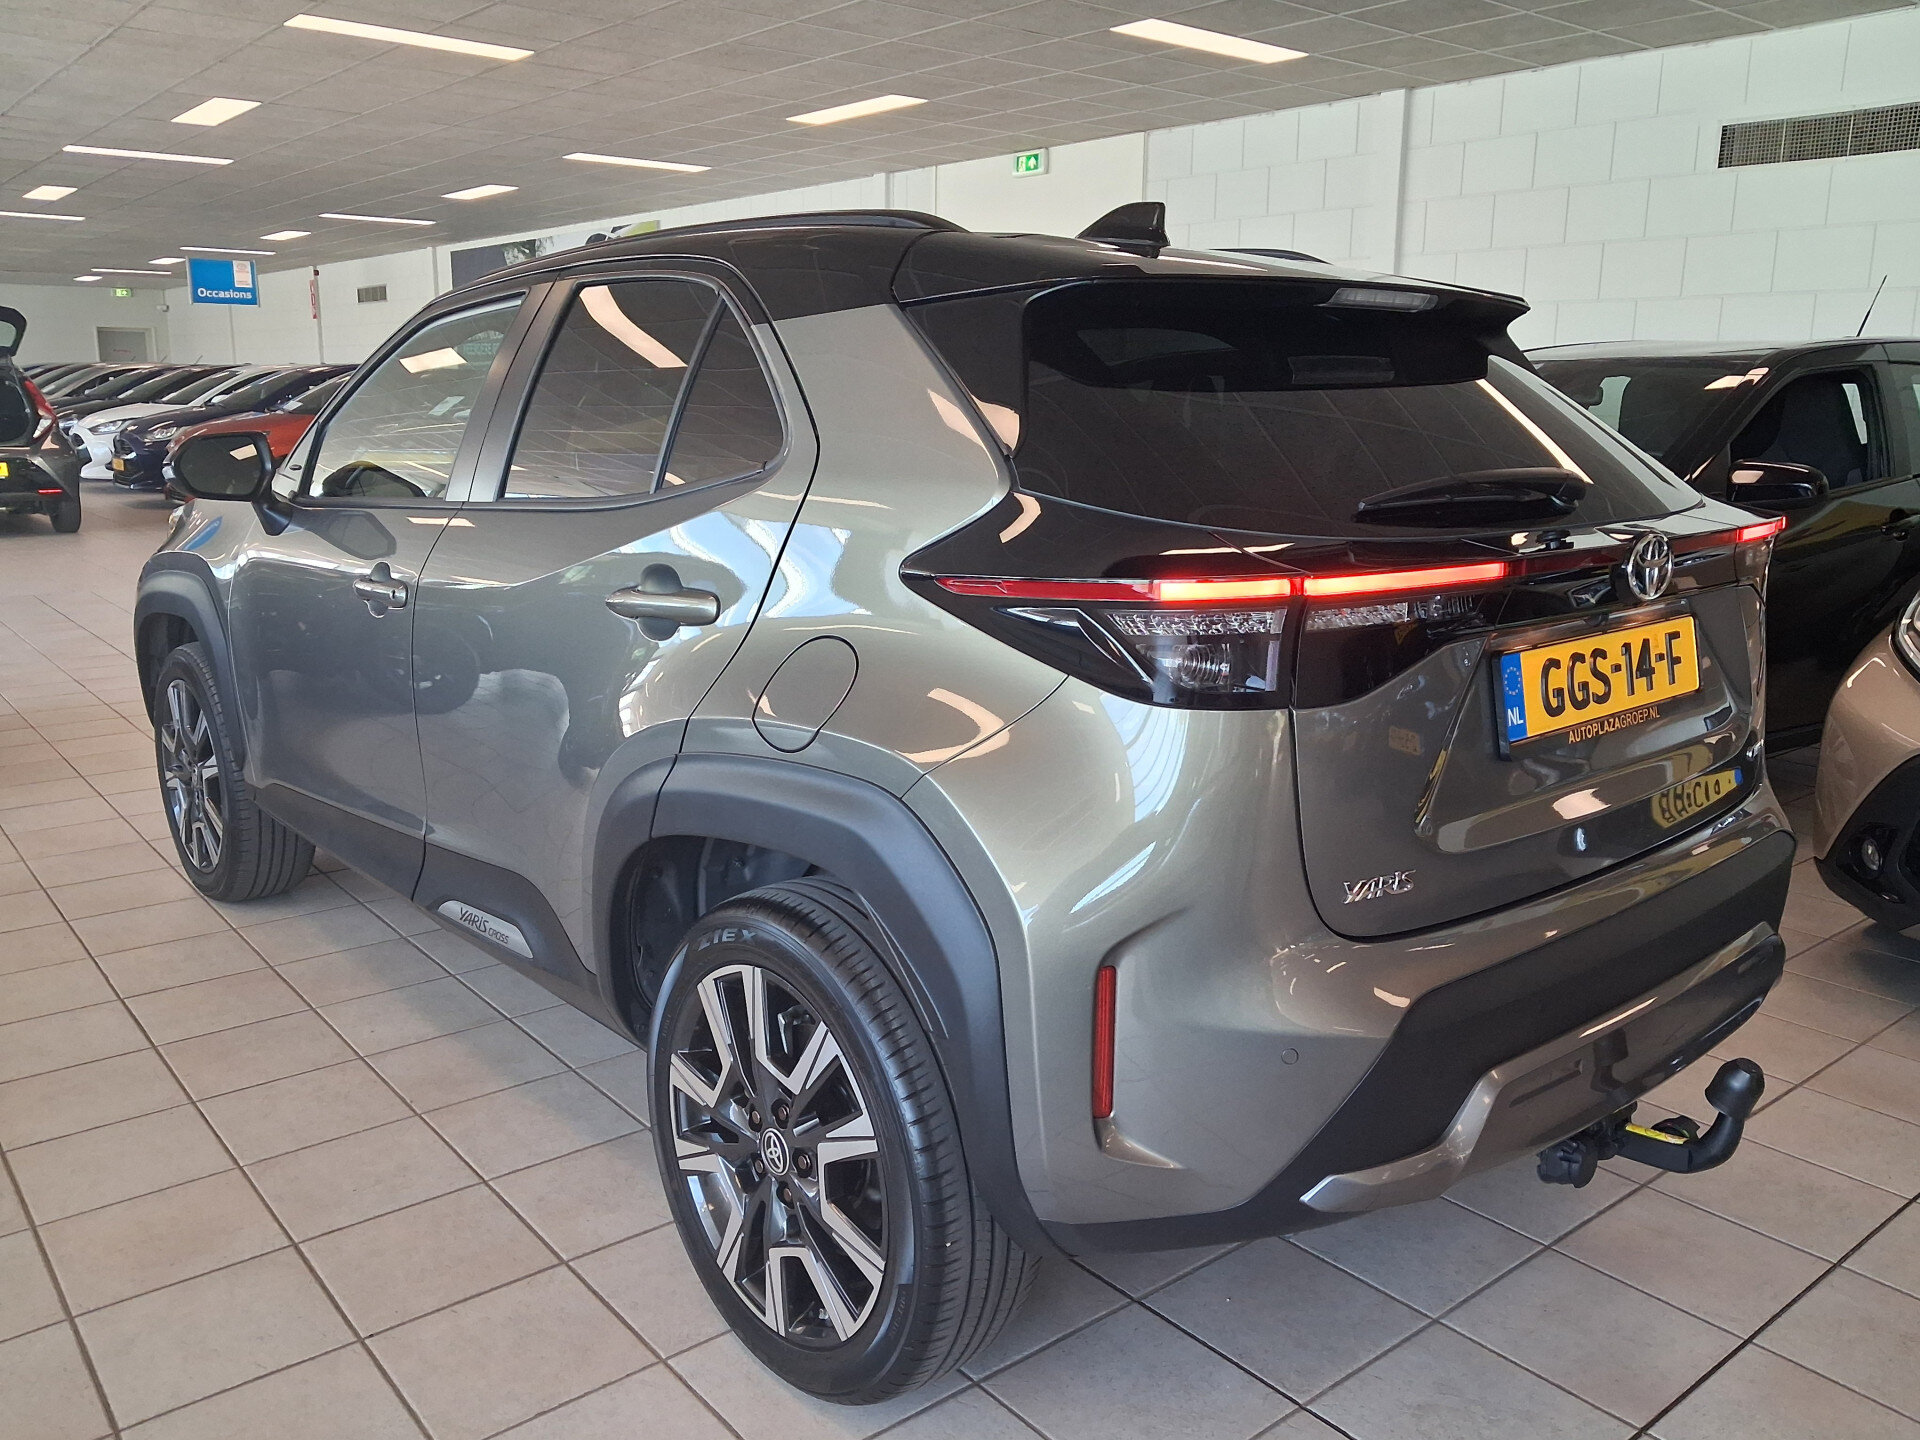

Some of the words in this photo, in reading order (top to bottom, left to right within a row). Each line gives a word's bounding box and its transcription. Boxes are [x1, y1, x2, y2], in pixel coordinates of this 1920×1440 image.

[197, 287, 252, 299] Occasions
[1540, 630, 1682, 718] GGS-14-F
[1507, 706, 1524, 727] NL
[1568, 708, 1661, 744] AUTOPLAZAGROEP.NL
[460, 907, 489, 933] YARIS
[488, 927, 509, 945] CROSS
